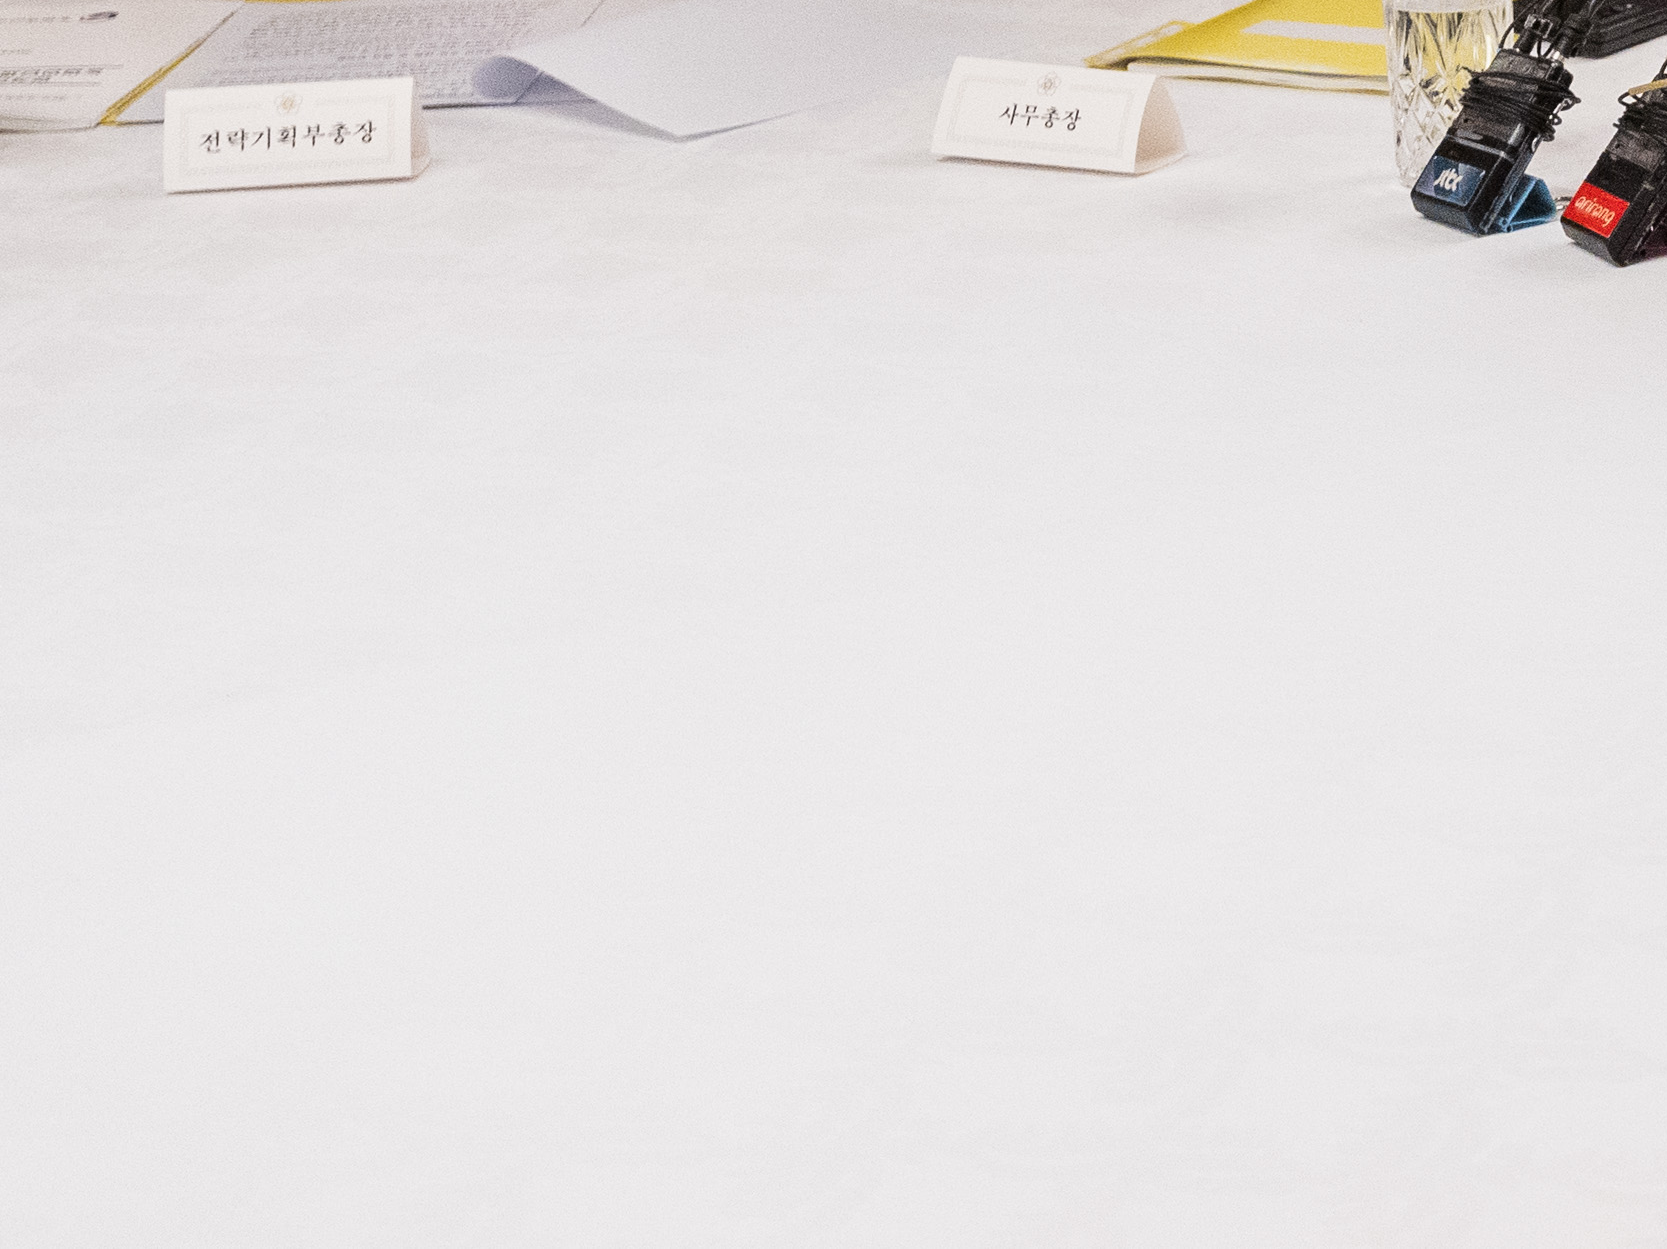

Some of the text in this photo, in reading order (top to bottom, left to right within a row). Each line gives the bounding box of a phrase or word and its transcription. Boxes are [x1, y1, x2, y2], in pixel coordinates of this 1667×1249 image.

[999, 103, 1081, 131] 사무총장
[200, 119, 377, 154] 전략기획부총장
[1575, 196, 1616, 227] arirang
